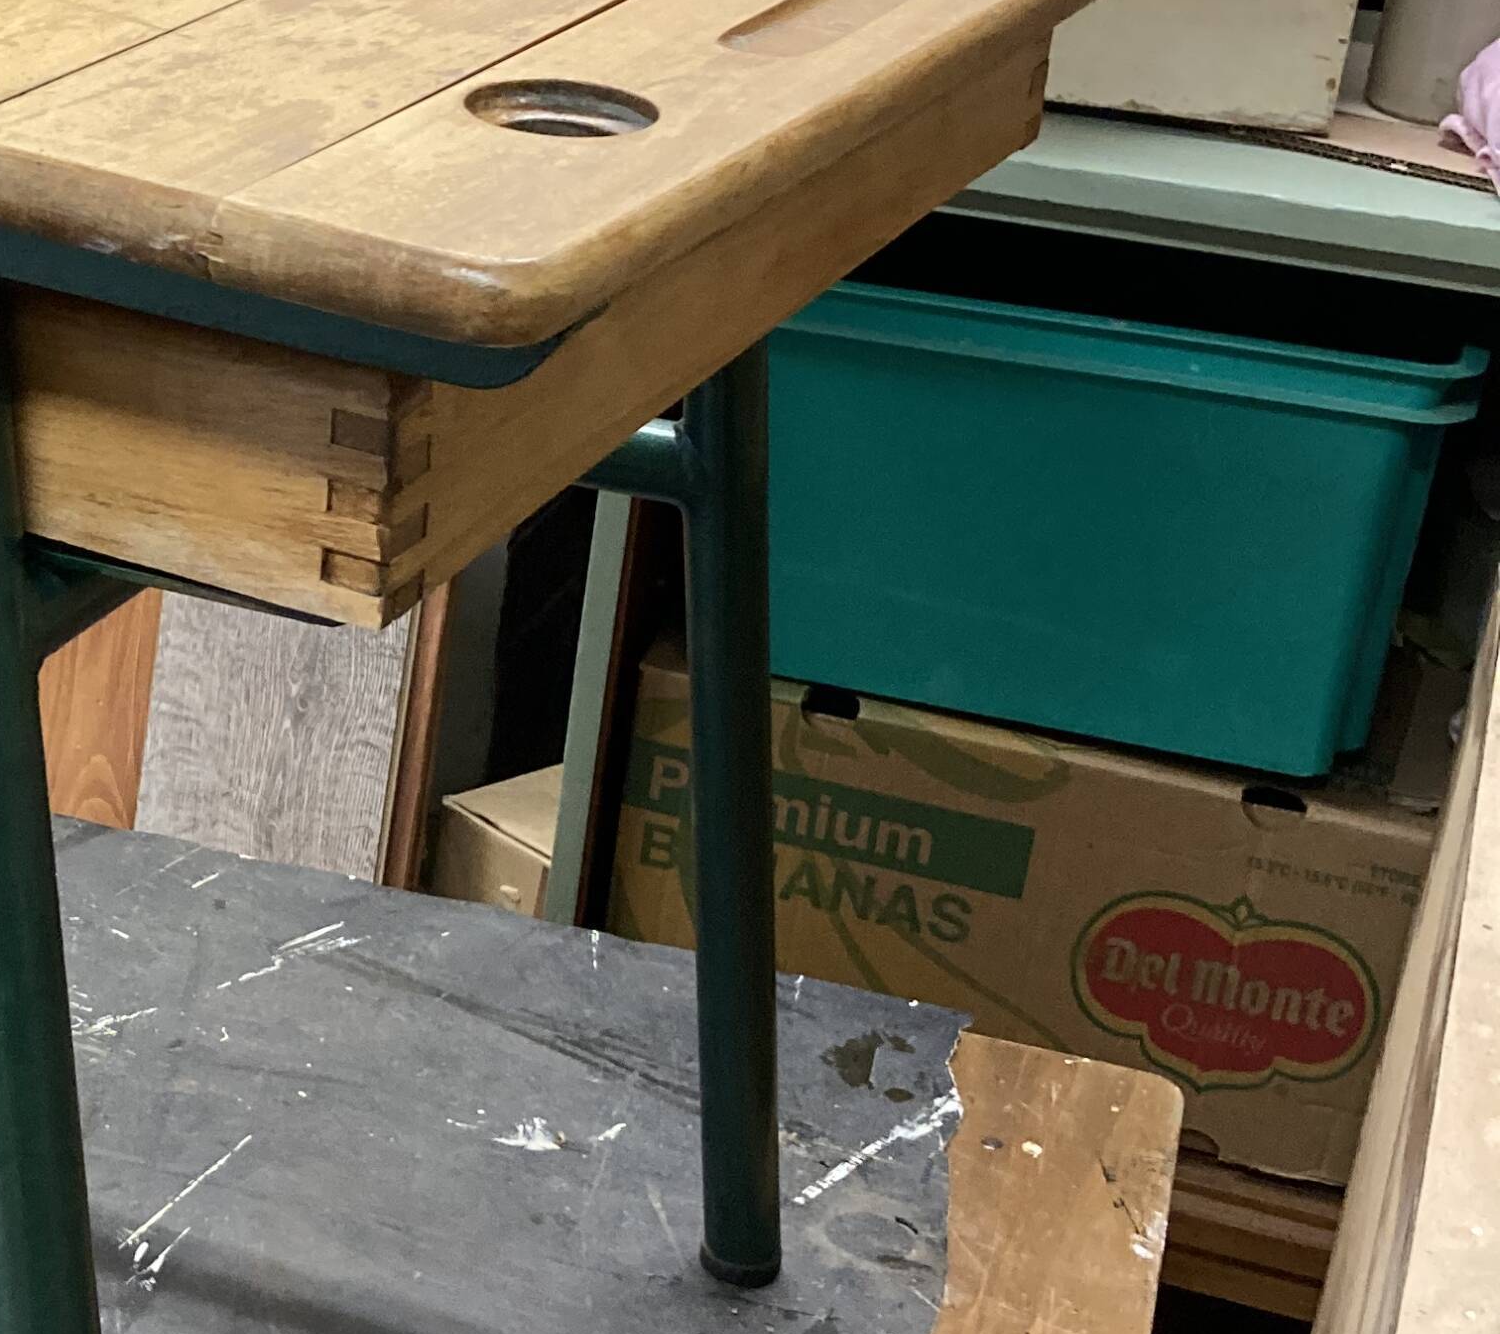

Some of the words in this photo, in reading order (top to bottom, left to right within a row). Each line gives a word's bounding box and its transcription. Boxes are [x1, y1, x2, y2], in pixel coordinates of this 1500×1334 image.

[650, 754, 933, 866] Pmium
[640, 819, 974, 944] BANAS
[1102, 937, 1182, 998] Del
[1191, 957, 1356, 1039] Monte
